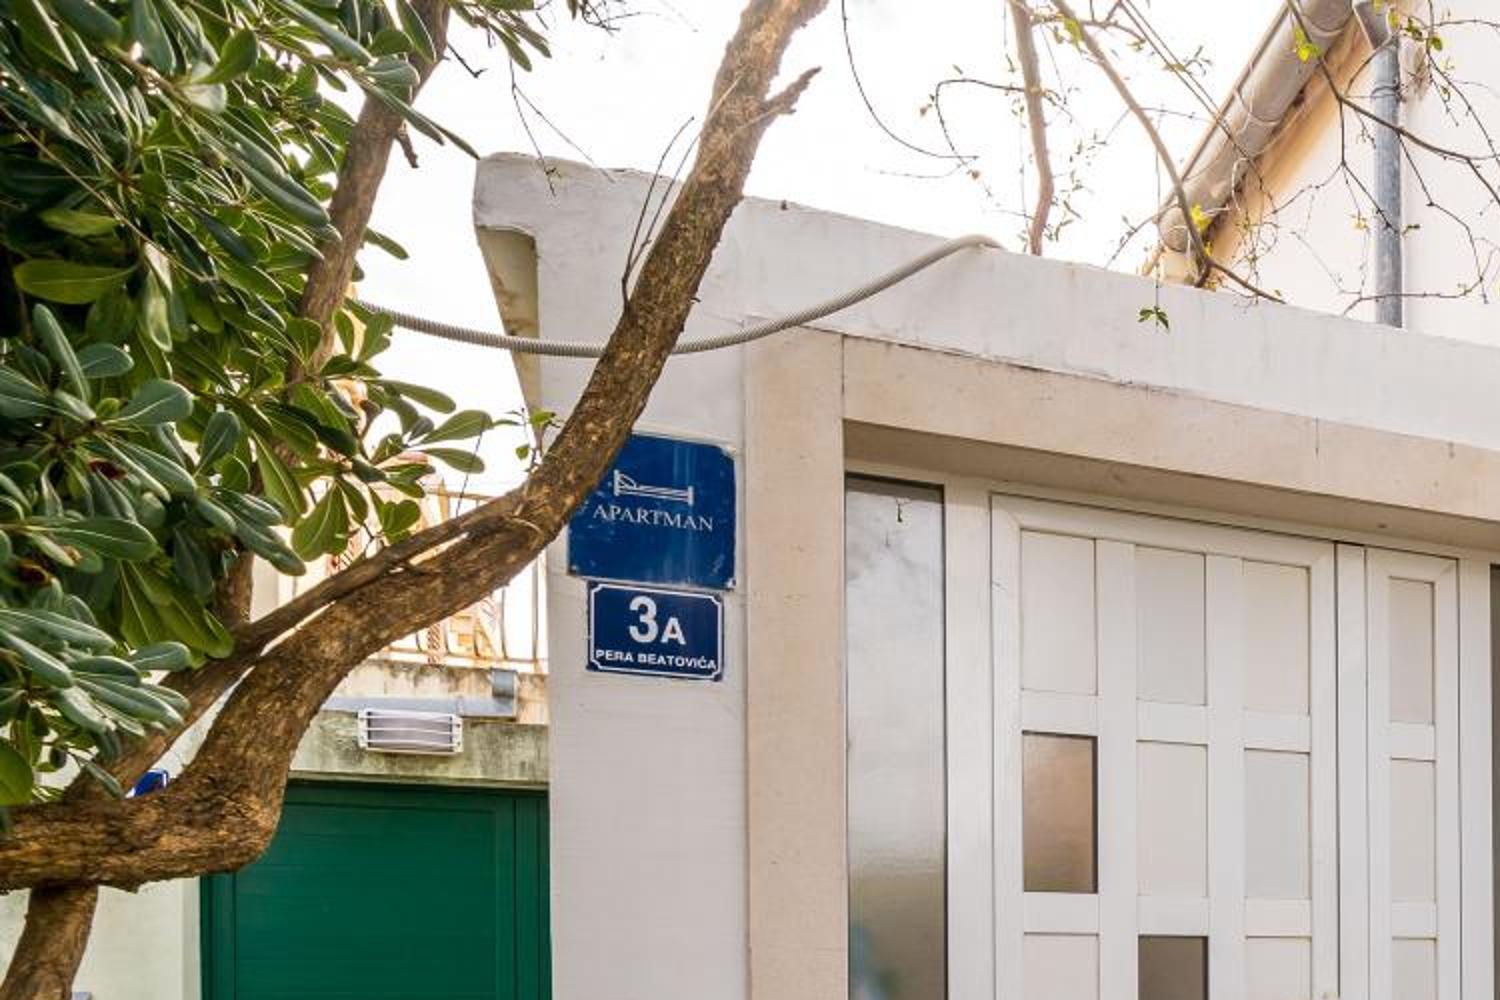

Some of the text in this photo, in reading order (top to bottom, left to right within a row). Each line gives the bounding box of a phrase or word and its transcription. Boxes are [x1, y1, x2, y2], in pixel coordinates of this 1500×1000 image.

[592, 504, 714, 532] APARTMAN
[629, 595, 687, 646] 3A
[595, 649, 717, 670] PERA BEATOVIĆA
